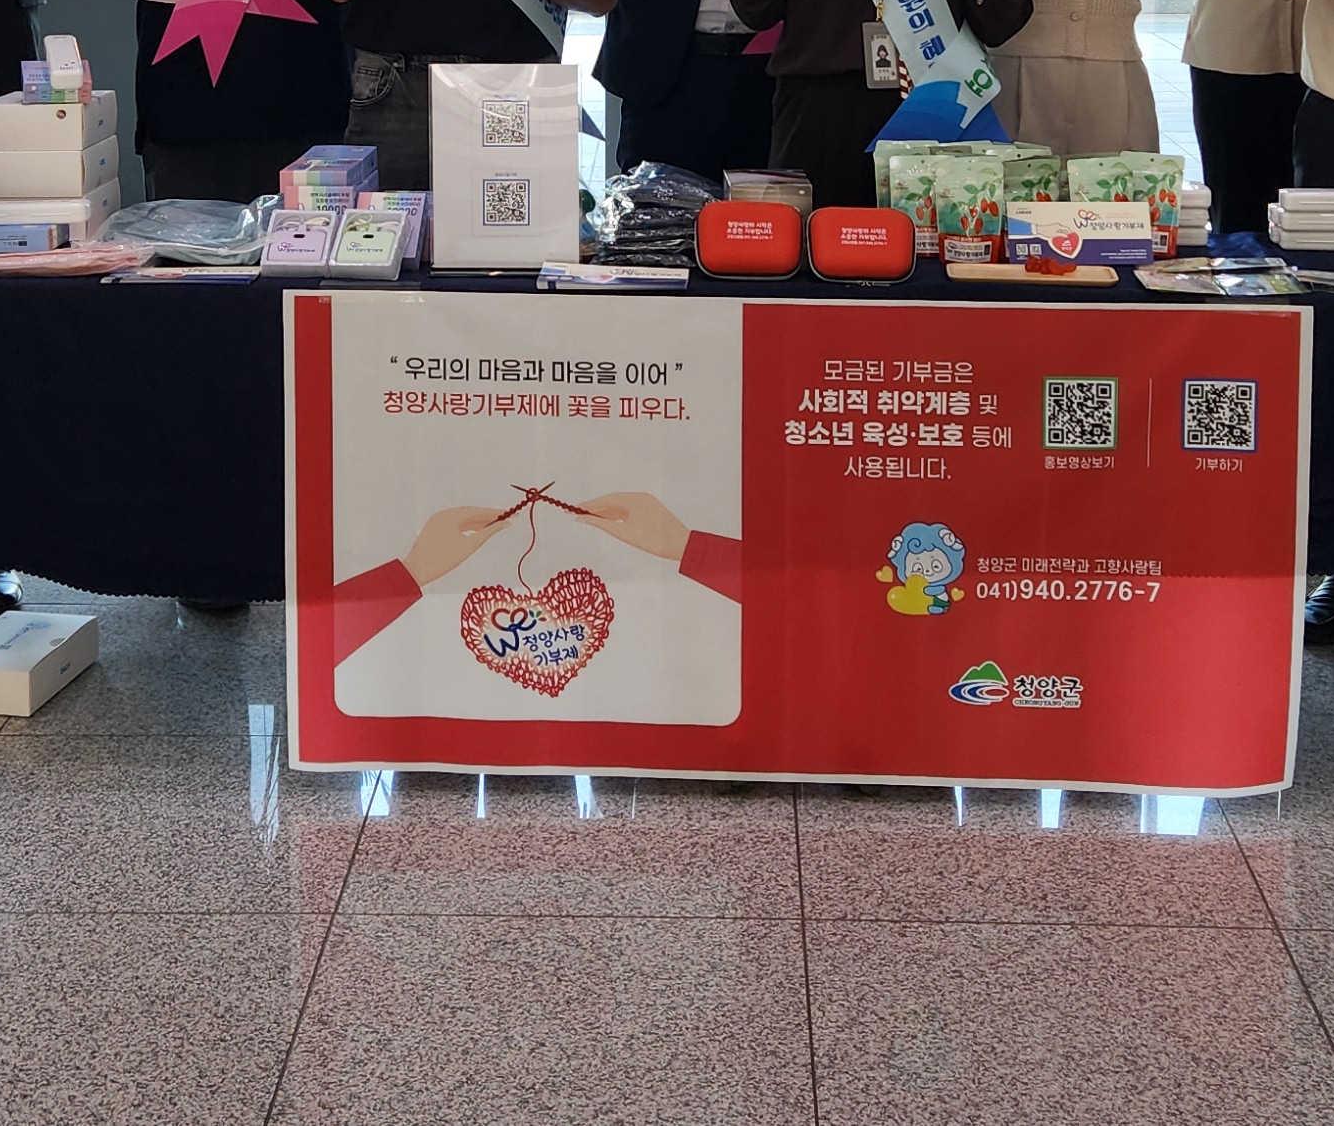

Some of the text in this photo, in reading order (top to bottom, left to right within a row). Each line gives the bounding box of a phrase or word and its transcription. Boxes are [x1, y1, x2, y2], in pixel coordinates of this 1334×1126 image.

[404, 357, 470, 381] 우리의
[478, 358, 544, 382] 마음과
[551, 359, 617, 385] 마음을
[625, 362, 668, 386] 이어
[823, 360, 974, 384] 모금된 기부금은
[382, 390, 691, 421] 청양사랑기부제에 꽃을 피우다.
[798, 388, 998, 416] 사회적 취약계층 및
[784, 419, 854, 446] 청소년
[971, 425, 1012, 449] 등에
[843, 455, 952, 480] 사용됩니다.
[1043, 456, 1115, 469] 홍보영상보기
[1194, 457, 1243, 472] 기부하기
[976, 557, 1162, 576] 청양군 미래전략과 고향사랑팀
[976, 578, 1161, 603] 041)940.2776-7
[522, 623, 586, 652] 청양사랑
[533, 644, 579, 666] 기부제
[1014, 675, 1083, 698] 청양군
